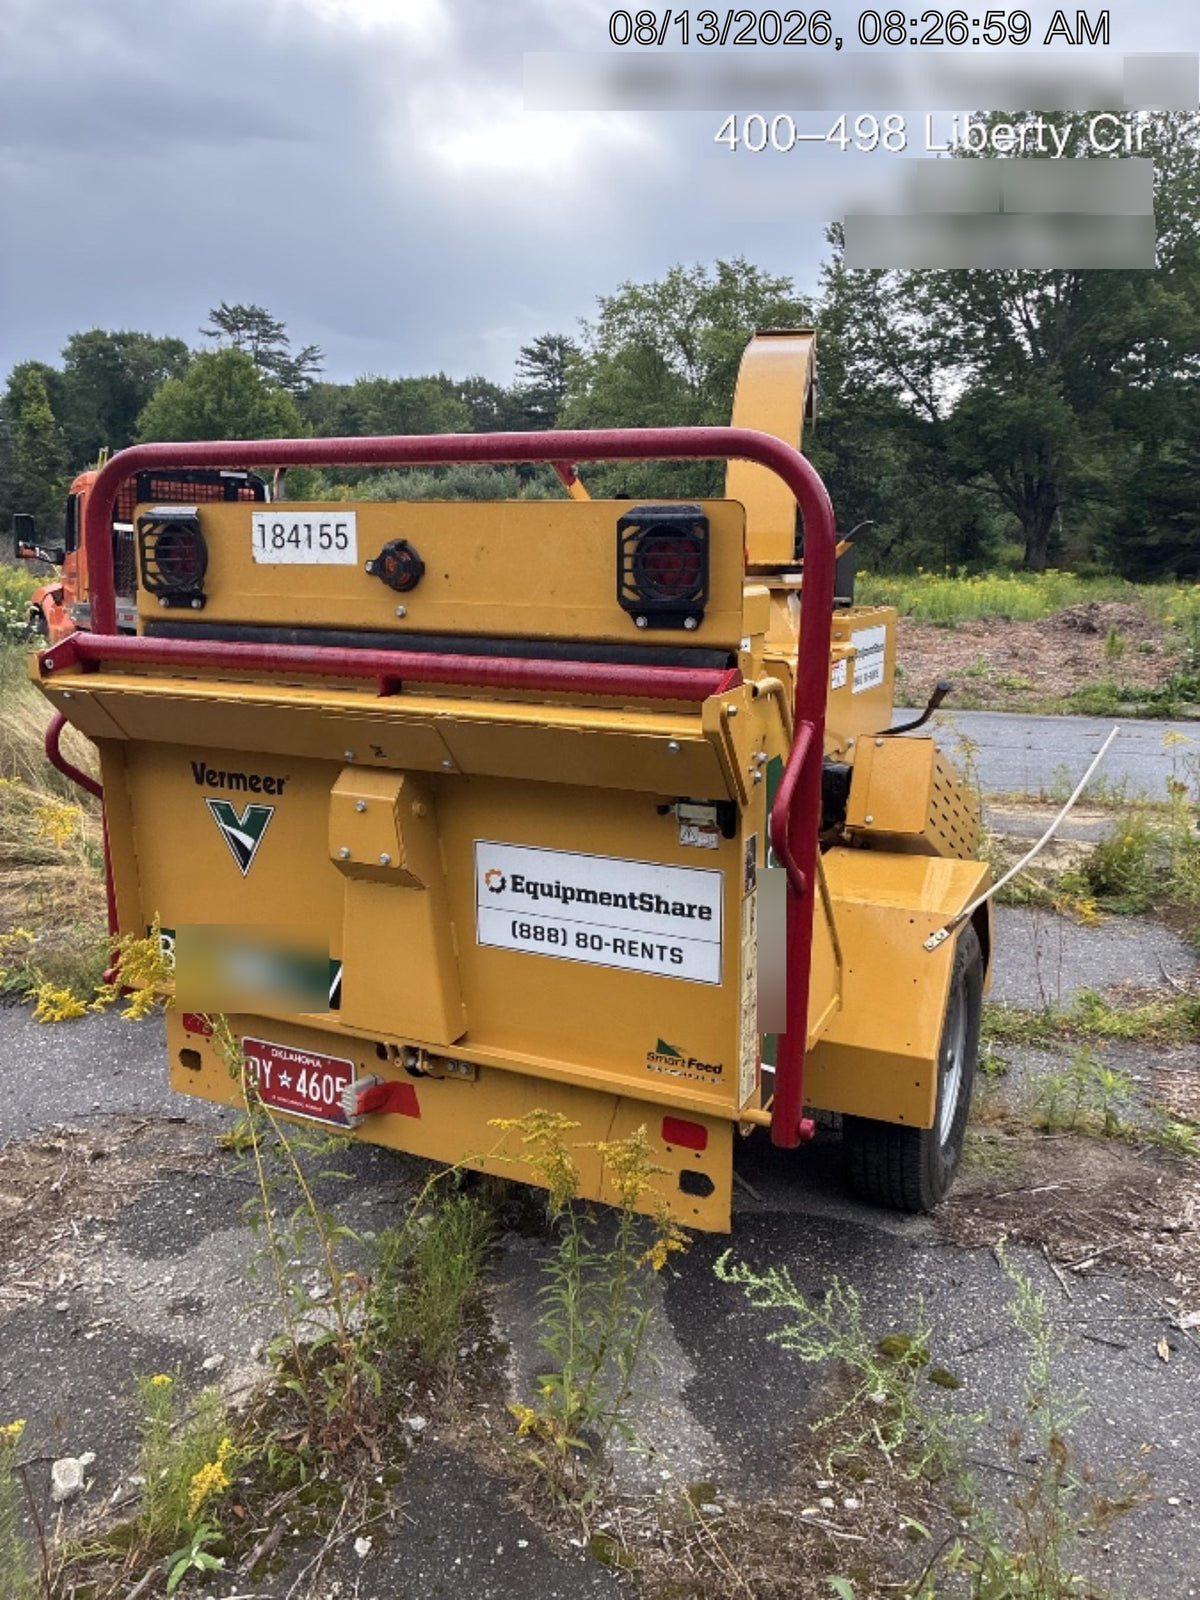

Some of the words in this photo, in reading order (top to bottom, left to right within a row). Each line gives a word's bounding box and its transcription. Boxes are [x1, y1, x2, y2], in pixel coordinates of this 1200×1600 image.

[257, 523, 349, 550] 184155
[190, 760, 286, 796] Vermeer
[510, 874, 713, 921] EquipmentShare
[511, 919, 568, 946] (888)
[575, 932, 684, 965] 80-RENTS
